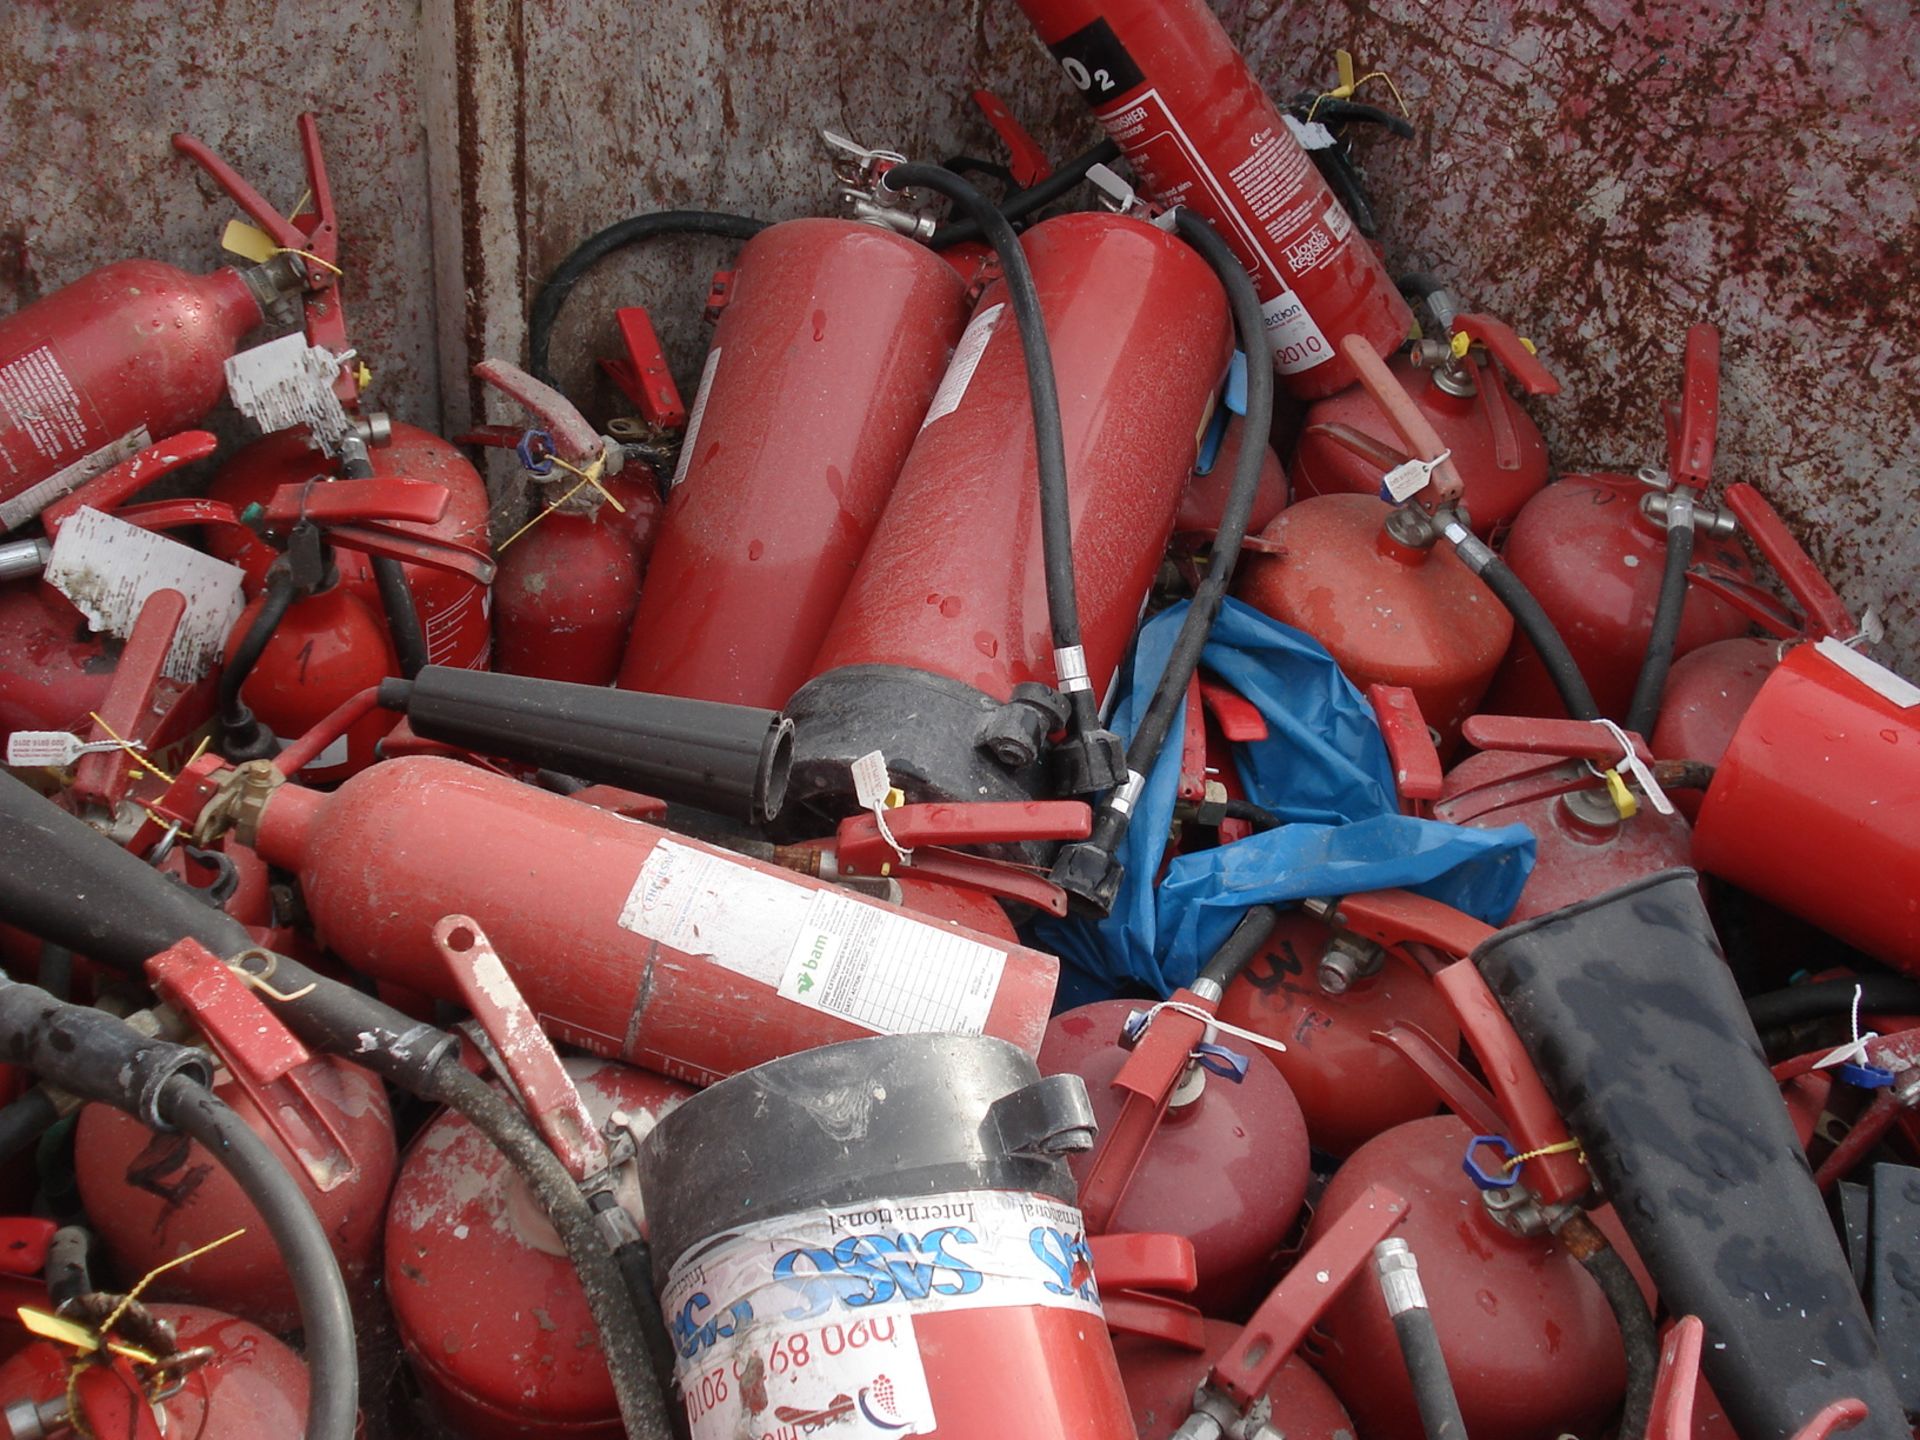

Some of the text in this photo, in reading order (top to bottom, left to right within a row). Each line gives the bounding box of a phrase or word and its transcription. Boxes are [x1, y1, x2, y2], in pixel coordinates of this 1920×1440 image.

[1286, 228, 1325, 260] Lloyd's
[1288, 235, 1332, 272] Register
[1276, 336, 1321, 365] 2010
[802, 934, 828, 970] bam
[830, 1202, 977, 1235] International
